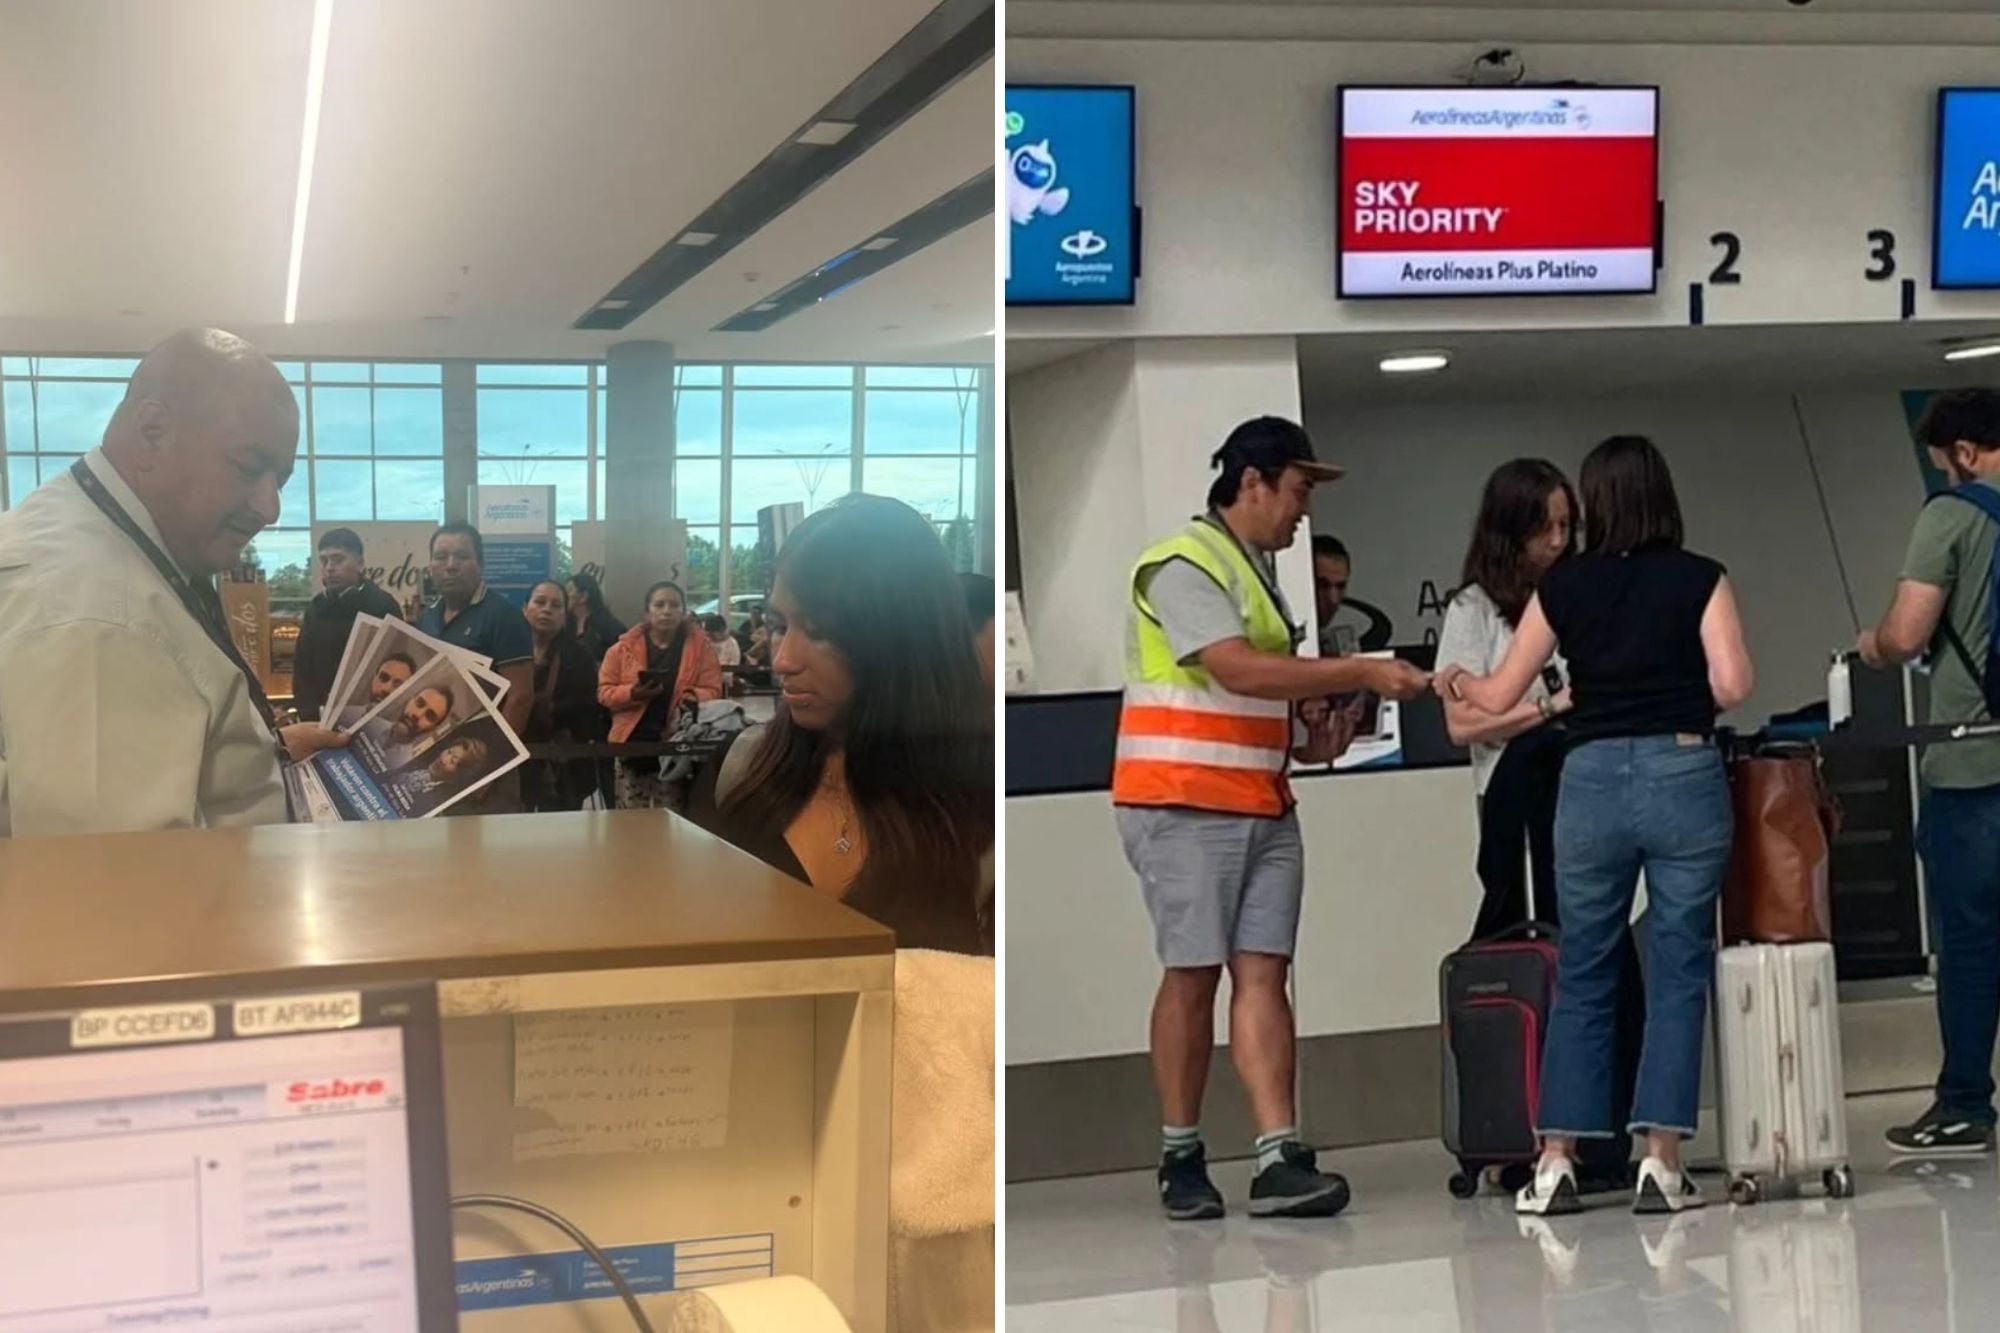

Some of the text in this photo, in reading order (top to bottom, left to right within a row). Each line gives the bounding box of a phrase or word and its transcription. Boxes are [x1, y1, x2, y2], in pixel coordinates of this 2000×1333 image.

[1971, 161, 2000, 195] A
[1355, 181, 1419, 206] SKY
[1355, 208, 1502, 233] PRIORITY
[1709, 232, 1741, 284] 2
[1865, 229, 1896, 280] 3
[1400, 260, 1597, 282] Aerolíneas Plus Platino
[350, 792, 376, 820] argenti
[360, 783, 381, 809] contra
[78, 1018, 108, 1038] BP
[239, 1006, 267, 1027] BT
[286, 1079, 385, 1103] Sabre
